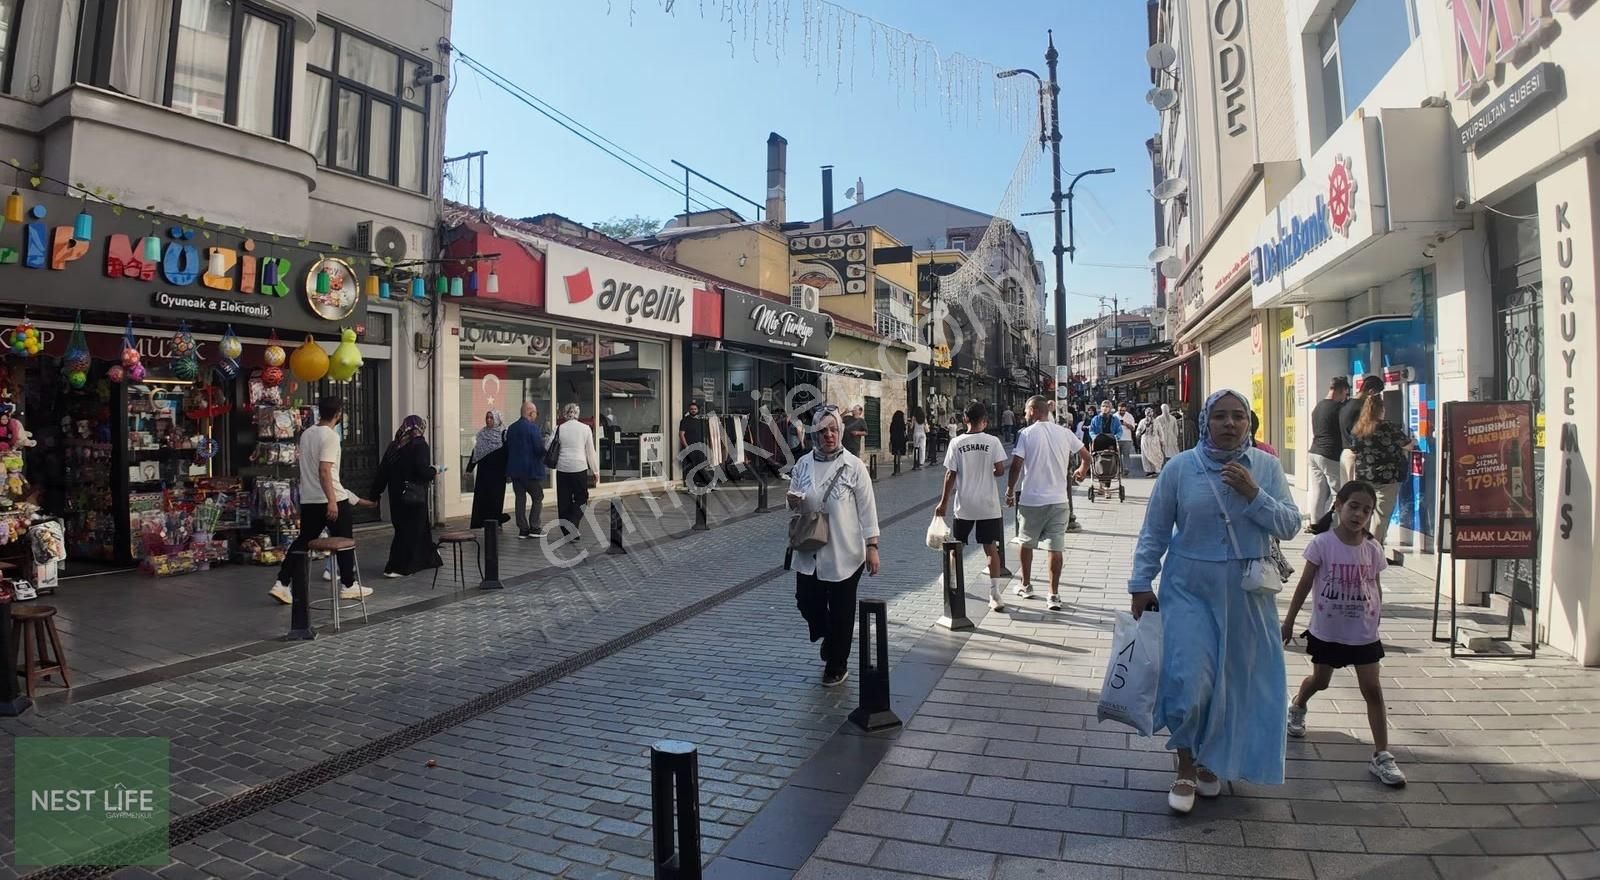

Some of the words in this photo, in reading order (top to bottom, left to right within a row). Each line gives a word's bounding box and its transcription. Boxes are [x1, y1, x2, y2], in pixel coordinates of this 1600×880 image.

[0, 204, 91, 270] İP
[161, 294, 206, 309] Oyuncak
[208, 300, 217, 310] &
[219, 301, 270, 316] Elektronik
[596, 277, 686, 323] arçelik
[751, 304, 780, 335] Mis
[778, 311, 814, 347] Türkiye
[122, 336, 207, 360] MÜZK
[1555, 201, 1580, 540] KURUYEMİŞ
[959, 443, 989, 454] FESHANE
[1456, 530, 1494, 542] ALMAK
[1497, 530, 1532, 541] LAZIM
